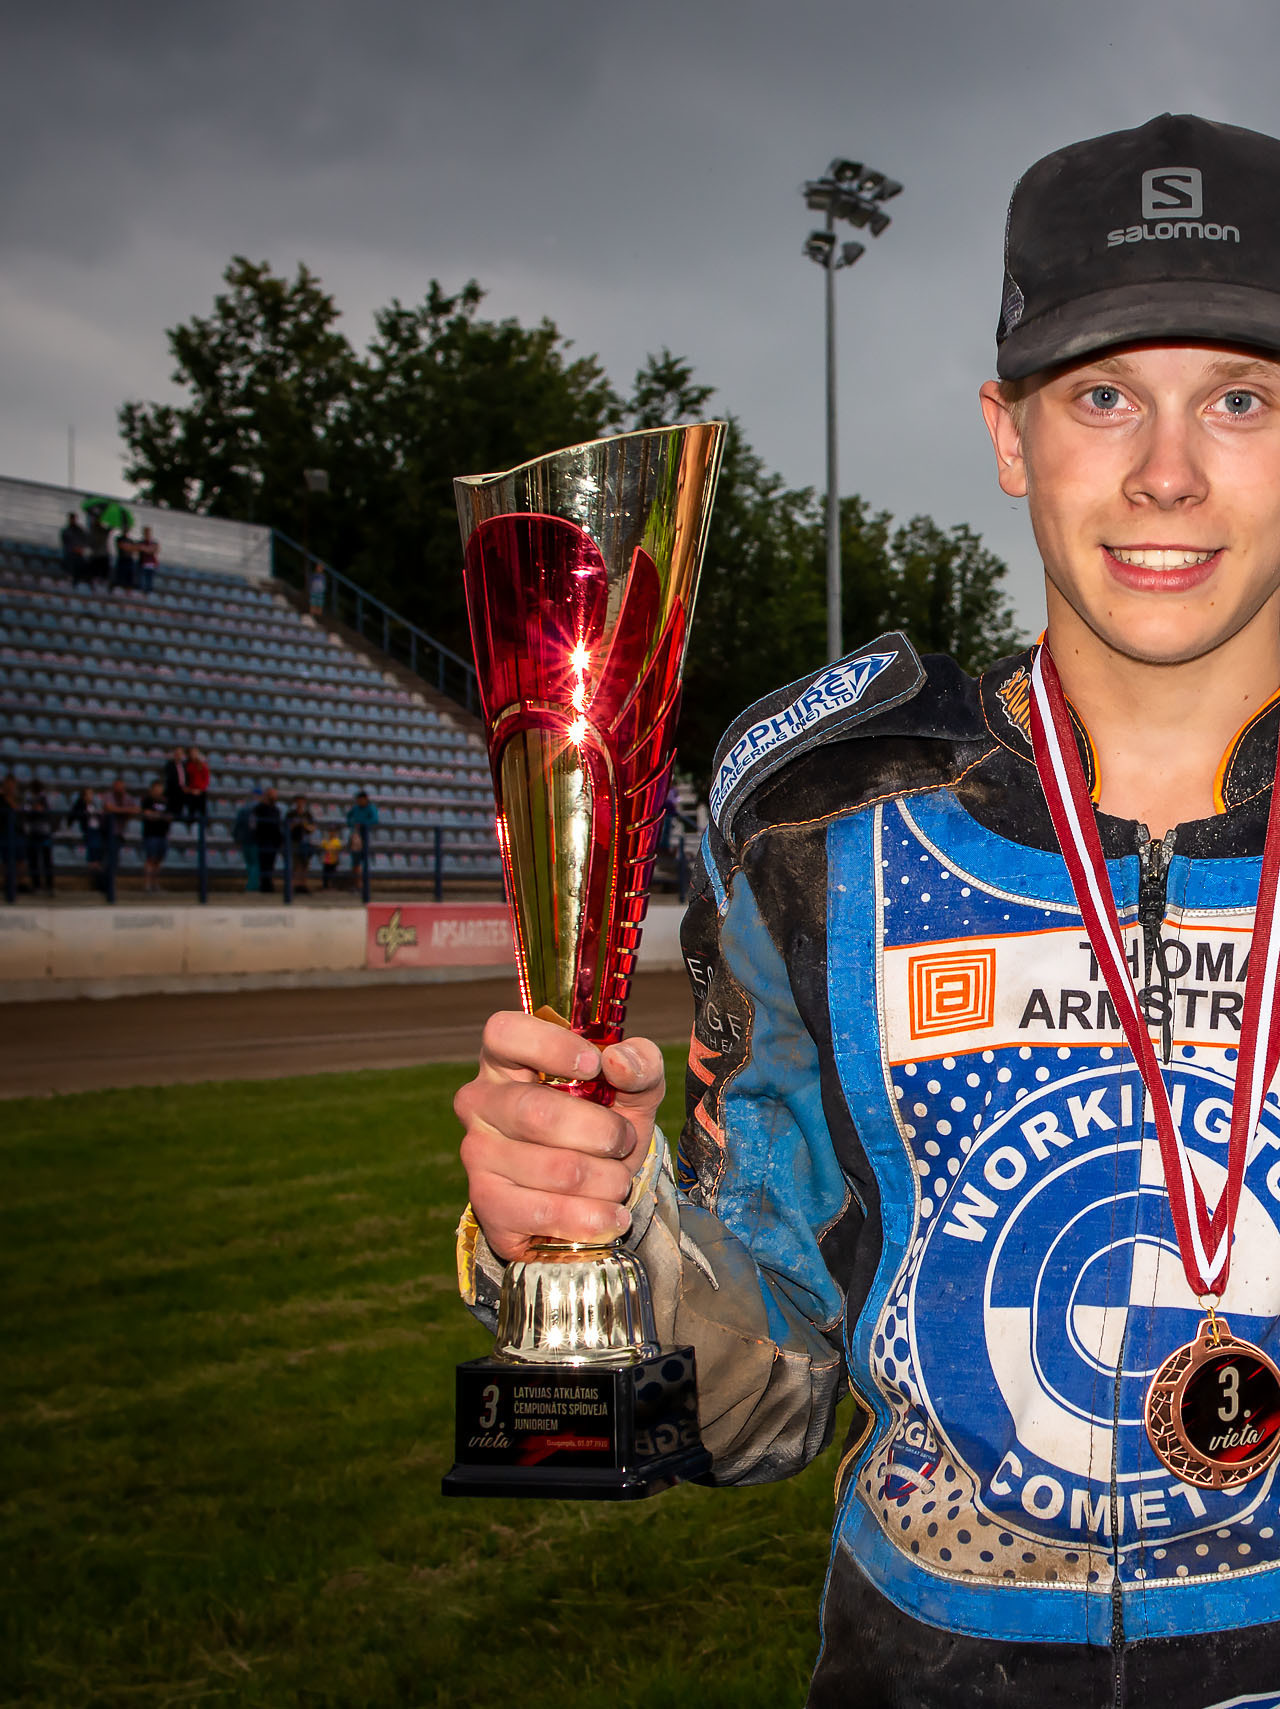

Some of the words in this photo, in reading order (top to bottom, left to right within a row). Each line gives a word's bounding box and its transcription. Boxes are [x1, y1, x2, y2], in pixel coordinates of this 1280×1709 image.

[708, 676, 849, 802] SAPPHIRE
[711, 731, 788, 822] ENGINEERING
[791, 707, 821, 735] (NE)
[822, 691, 855, 711] LTD
[479, 1384, 506, 1429] 3.
[513, 1386, 552, 1399] LATVIJAS
[553, 1385, 599, 1400] ATKLĀTAIS
[1217, 1366, 1252, 1422] 3.
[467, 1431, 513, 1449] vieta
[513, 1418, 559, 1431] JUNIORIEM
[1208, 1423, 1266, 1451] vieta
[989, 1451, 1248, 1536] COMET
